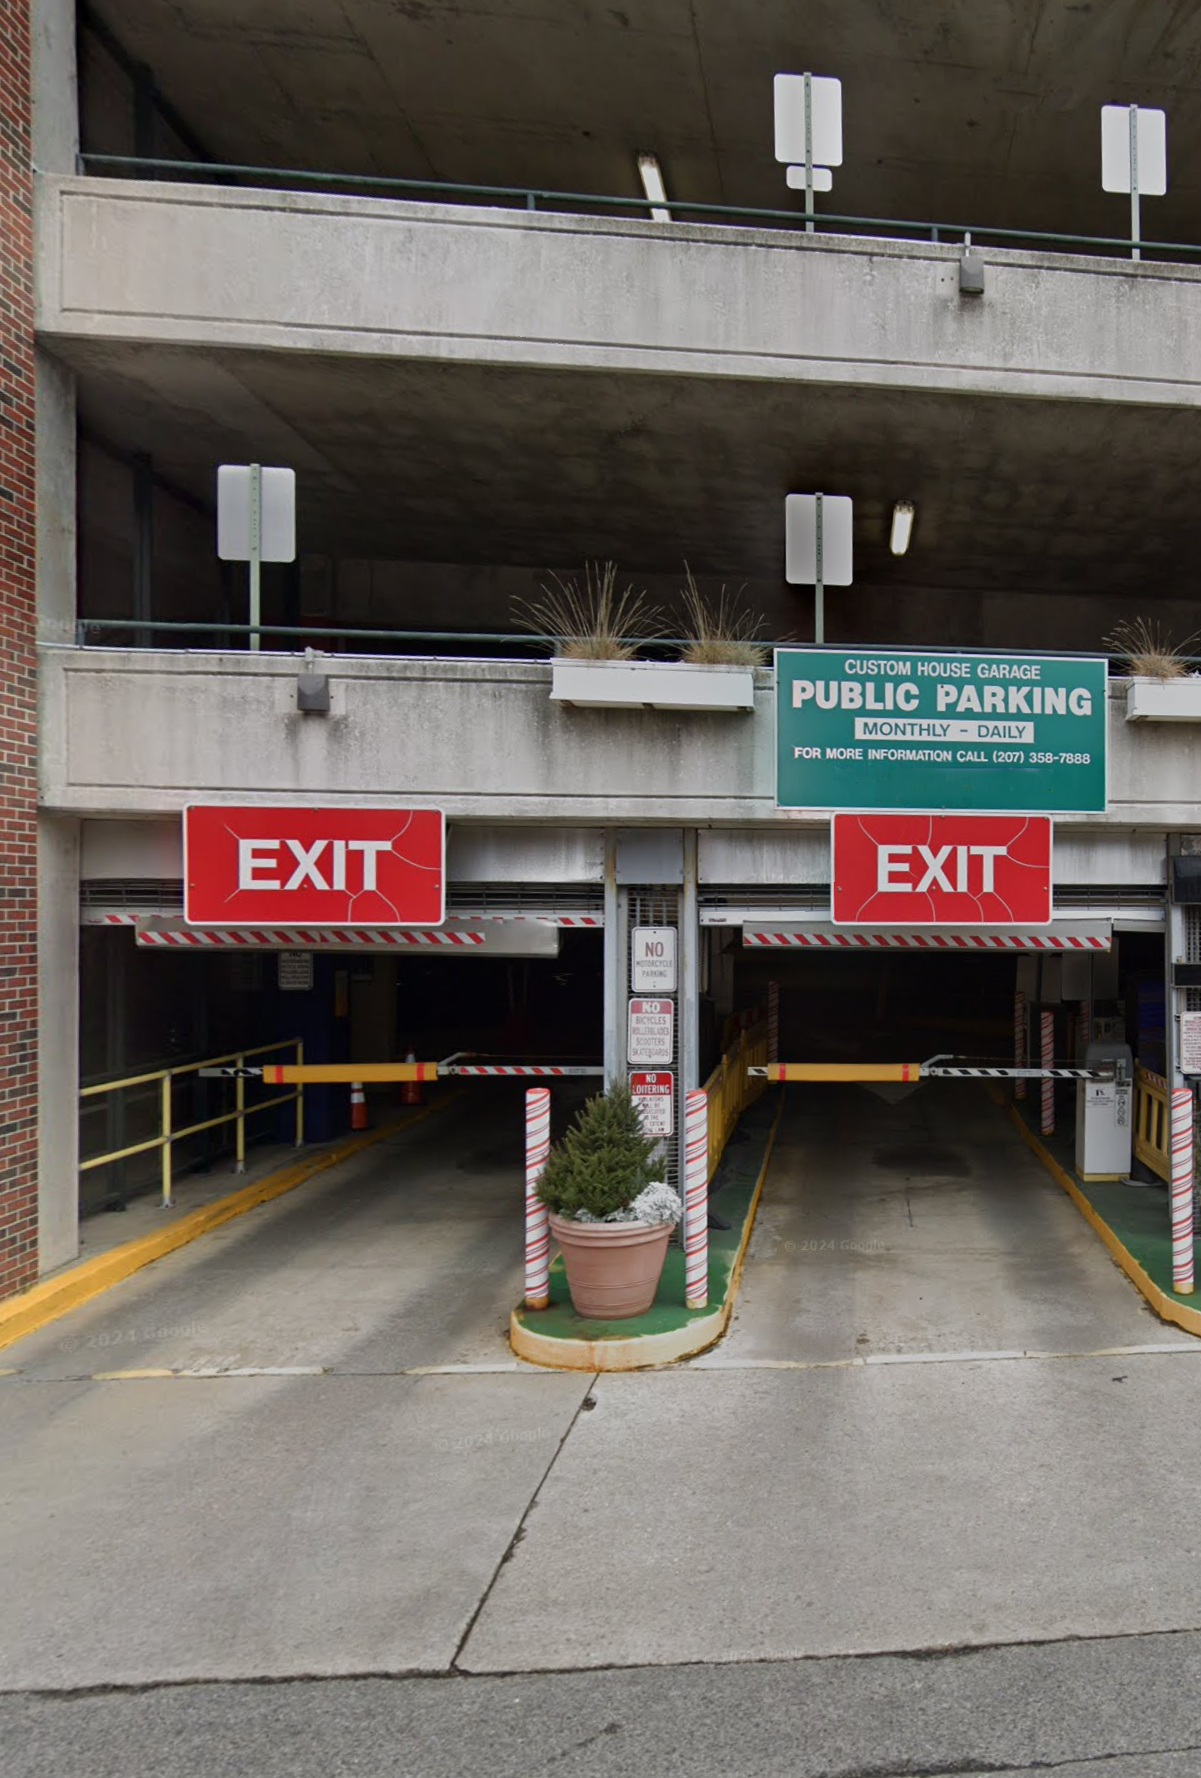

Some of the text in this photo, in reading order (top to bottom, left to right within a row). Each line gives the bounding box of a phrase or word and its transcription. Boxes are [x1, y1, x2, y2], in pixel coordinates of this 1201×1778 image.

[844, 659, 1041, 679] CUSTOM HOUSE GARAGE
[792, 679, 1092, 716] PUBLIC PARKING
[863, 722, 951, 737] MONTHLY
[978, 725, 1026, 739] DAILY
[793, 747, 1091, 764] FOR MORE INFORMATION CALL (207) 358-7888
[238, 838, 392, 891] EXIT
[877, 844, 1007, 893] EXIT
[645, 942, 664, 957] NO
[636, 960, 673, 968] MOTORCYCLE
[642, 970, 667, 978] PARKING
[642, 1002, 660, 1013] NO
[635, 1016, 666, 1025] BICYCLES
[632, 1027, 669, 1036] ROLLERBLADES
[636, 1037, 665, 1046] SCOOTERS
[632, 1048, 669, 1056] SKATEBOARDS
[646, 1073, 657, 1083] NO
[632, 1084, 670, 1094] LOITERING
